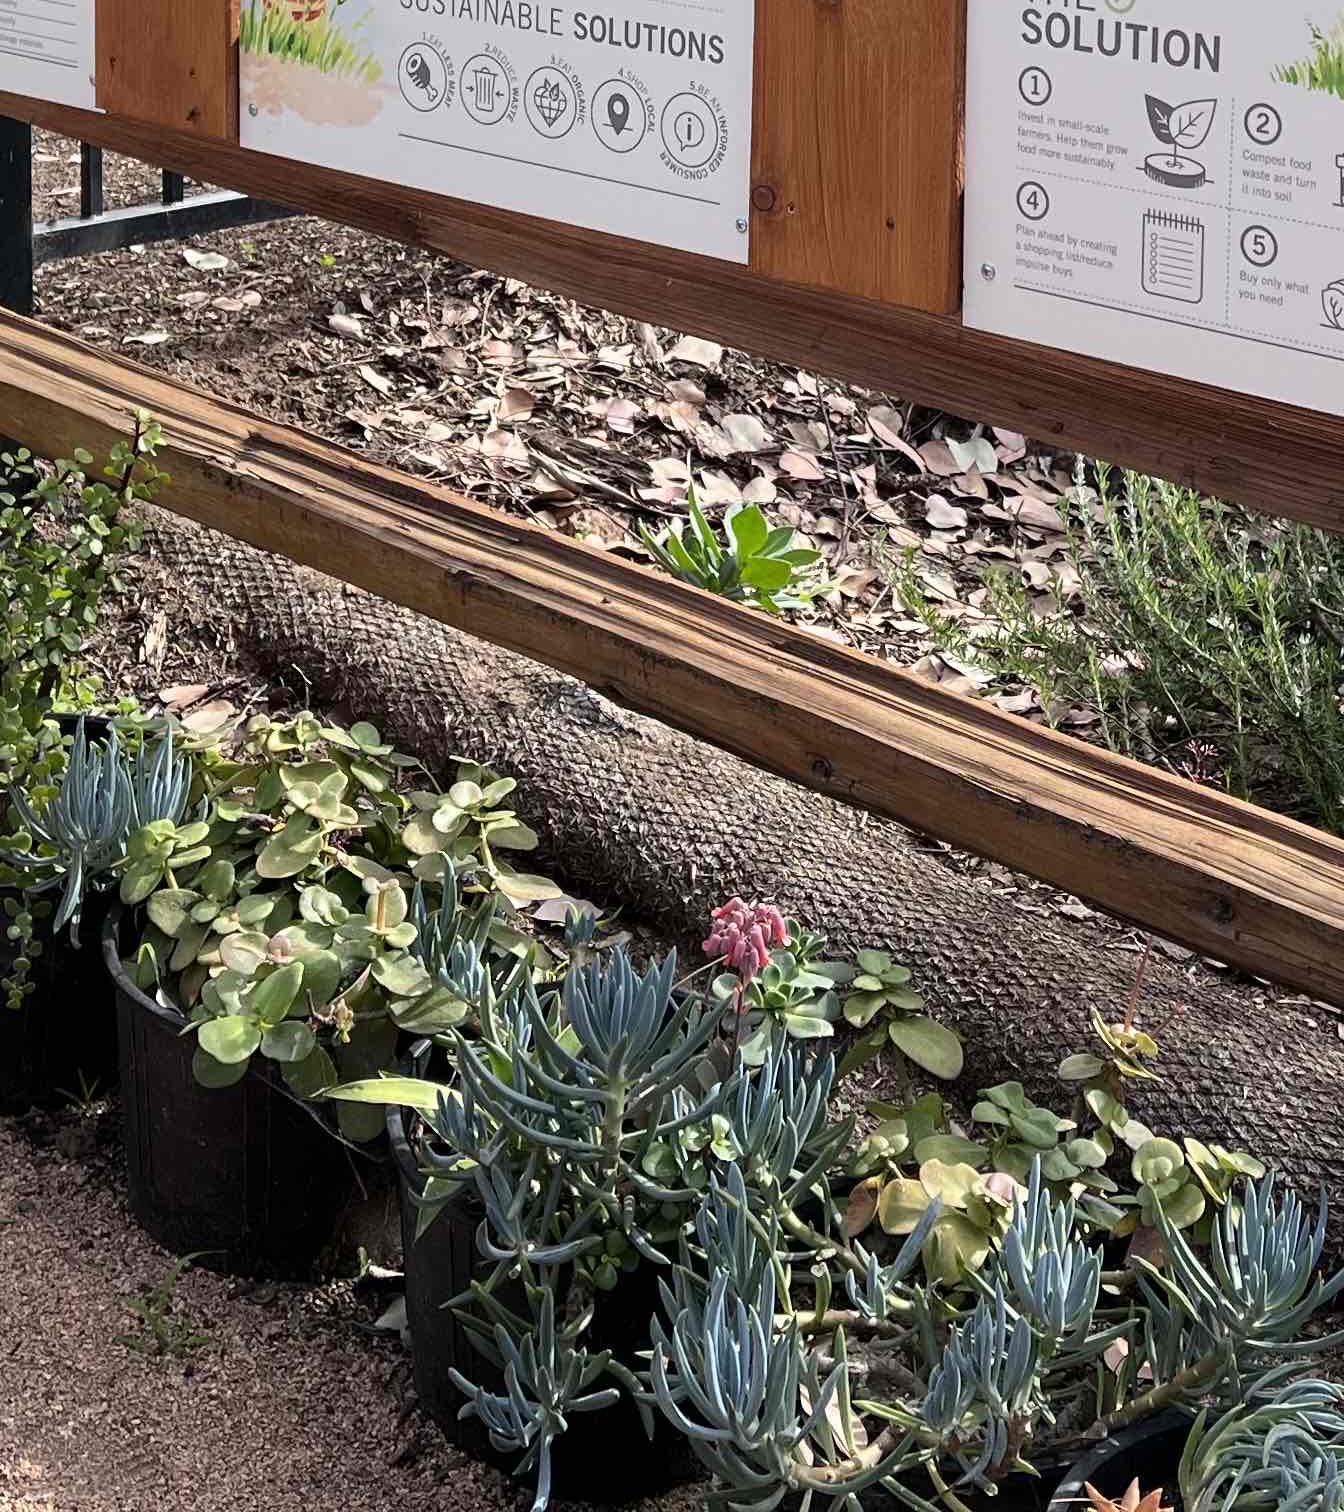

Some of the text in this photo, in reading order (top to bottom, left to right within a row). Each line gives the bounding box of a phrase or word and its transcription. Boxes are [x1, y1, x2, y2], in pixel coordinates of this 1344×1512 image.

[572, 10, 725, 66] SOLUTIONS
[1020, 7, 1222, 74] SOLUTION
[571, 74, 587, 125] ORGANIC
